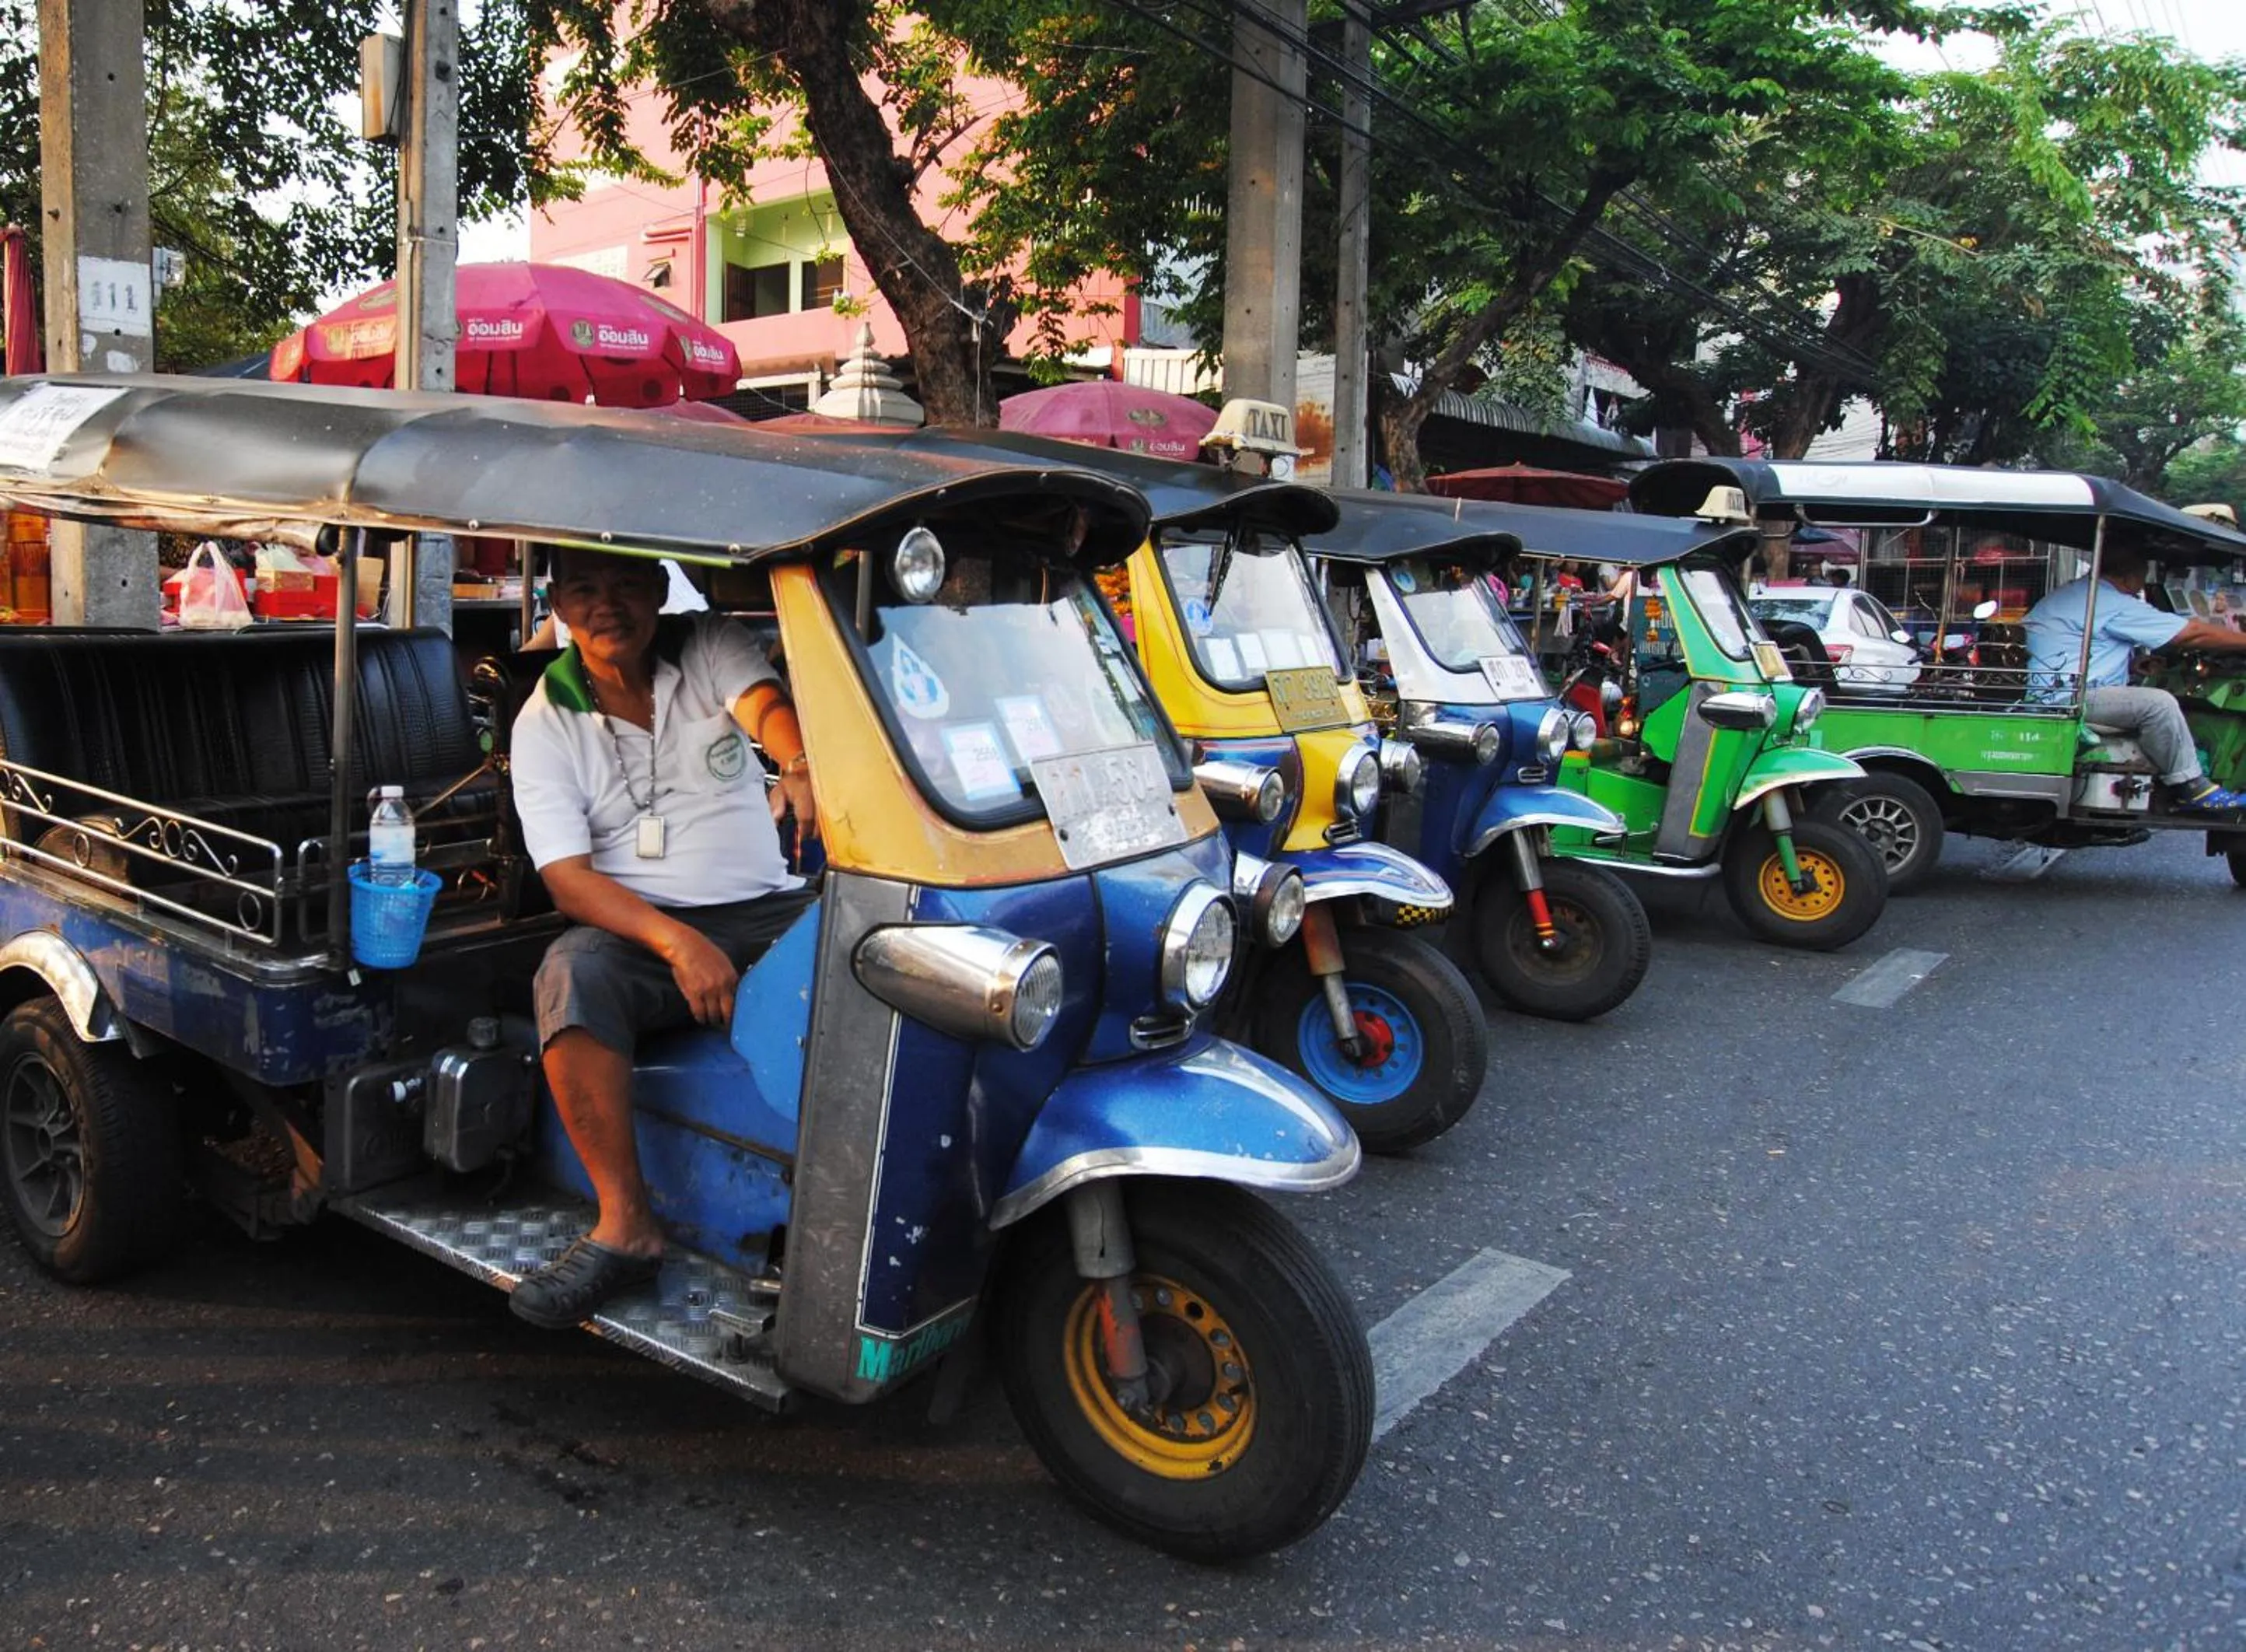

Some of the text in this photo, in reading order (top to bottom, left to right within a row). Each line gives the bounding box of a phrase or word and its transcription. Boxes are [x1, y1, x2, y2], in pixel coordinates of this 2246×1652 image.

[467, 320, 523, 336] ออมสิน
[598, 329, 649, 344] ออมสิน
[1248, 408, 1288, 443] TAXI
